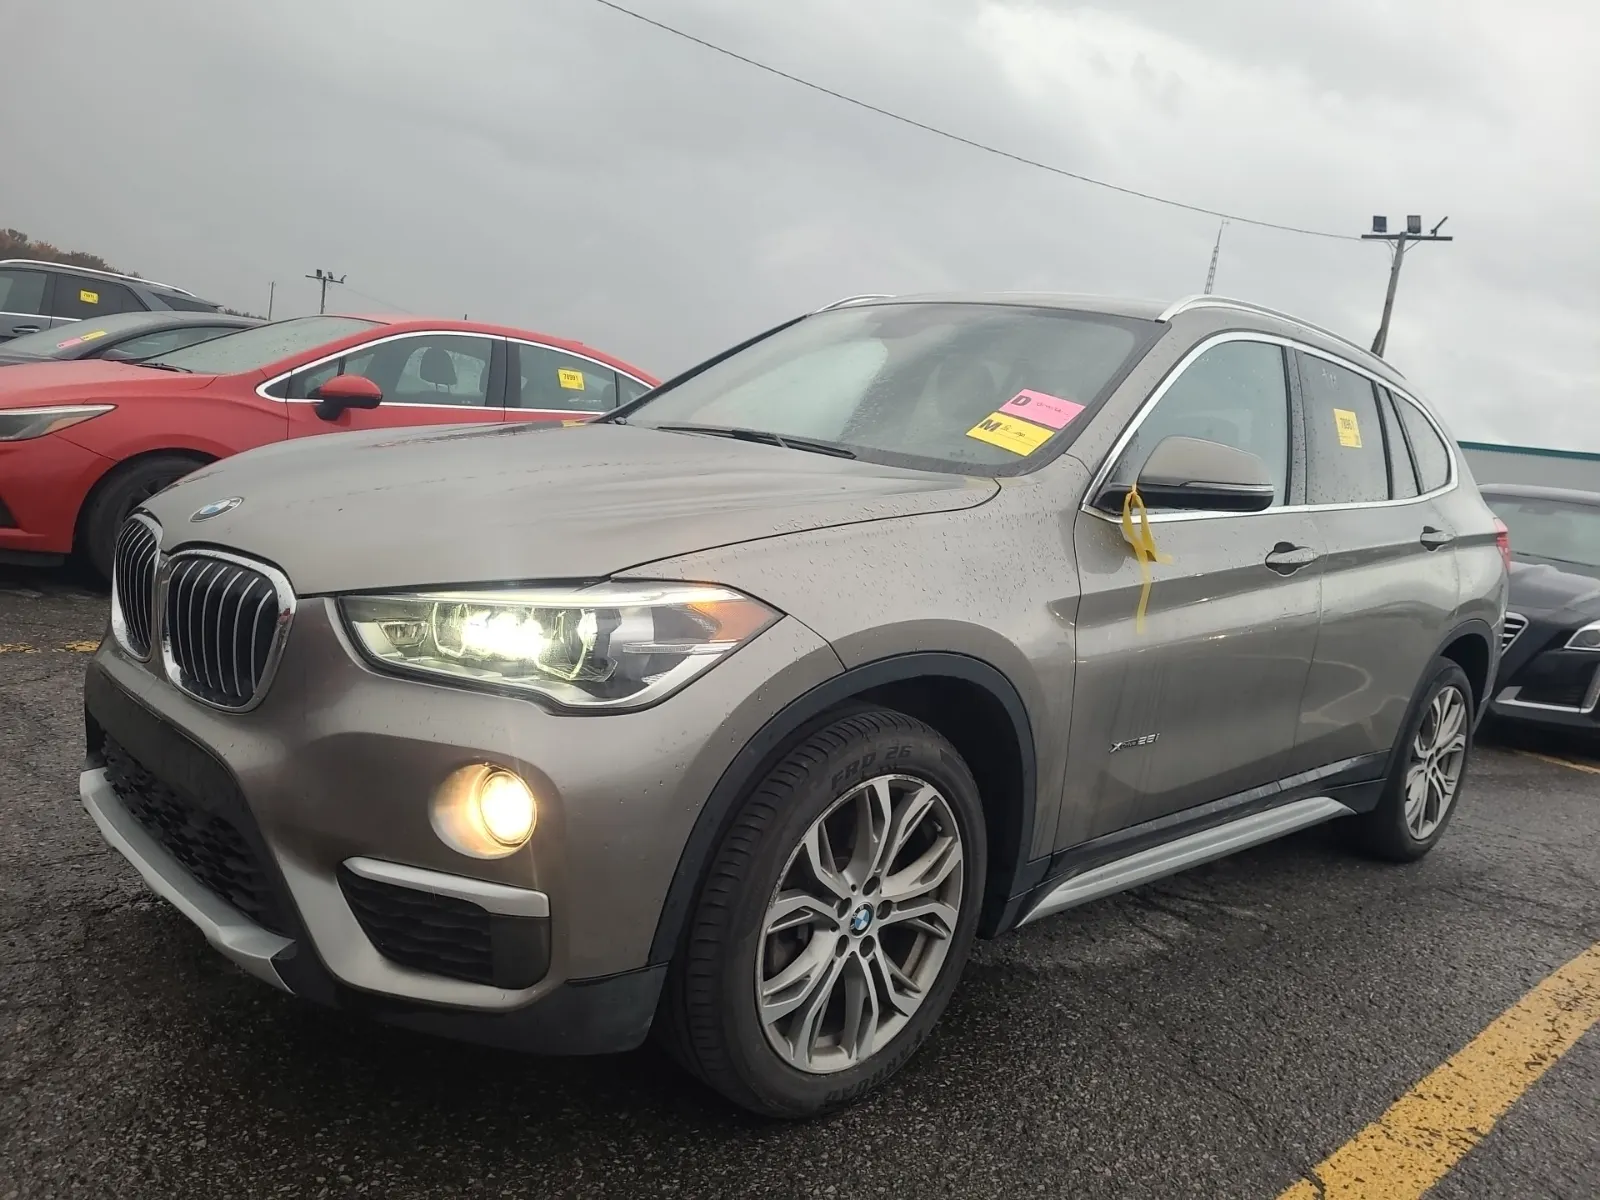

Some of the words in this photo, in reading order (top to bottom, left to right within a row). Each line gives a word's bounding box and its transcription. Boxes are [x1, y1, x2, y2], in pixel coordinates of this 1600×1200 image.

[1010, 395, 1032, 406] D
[978, 418, 1002, 432] M
[831, 751, 877, 790] FRD
[885, 745, 913, 760] 26
